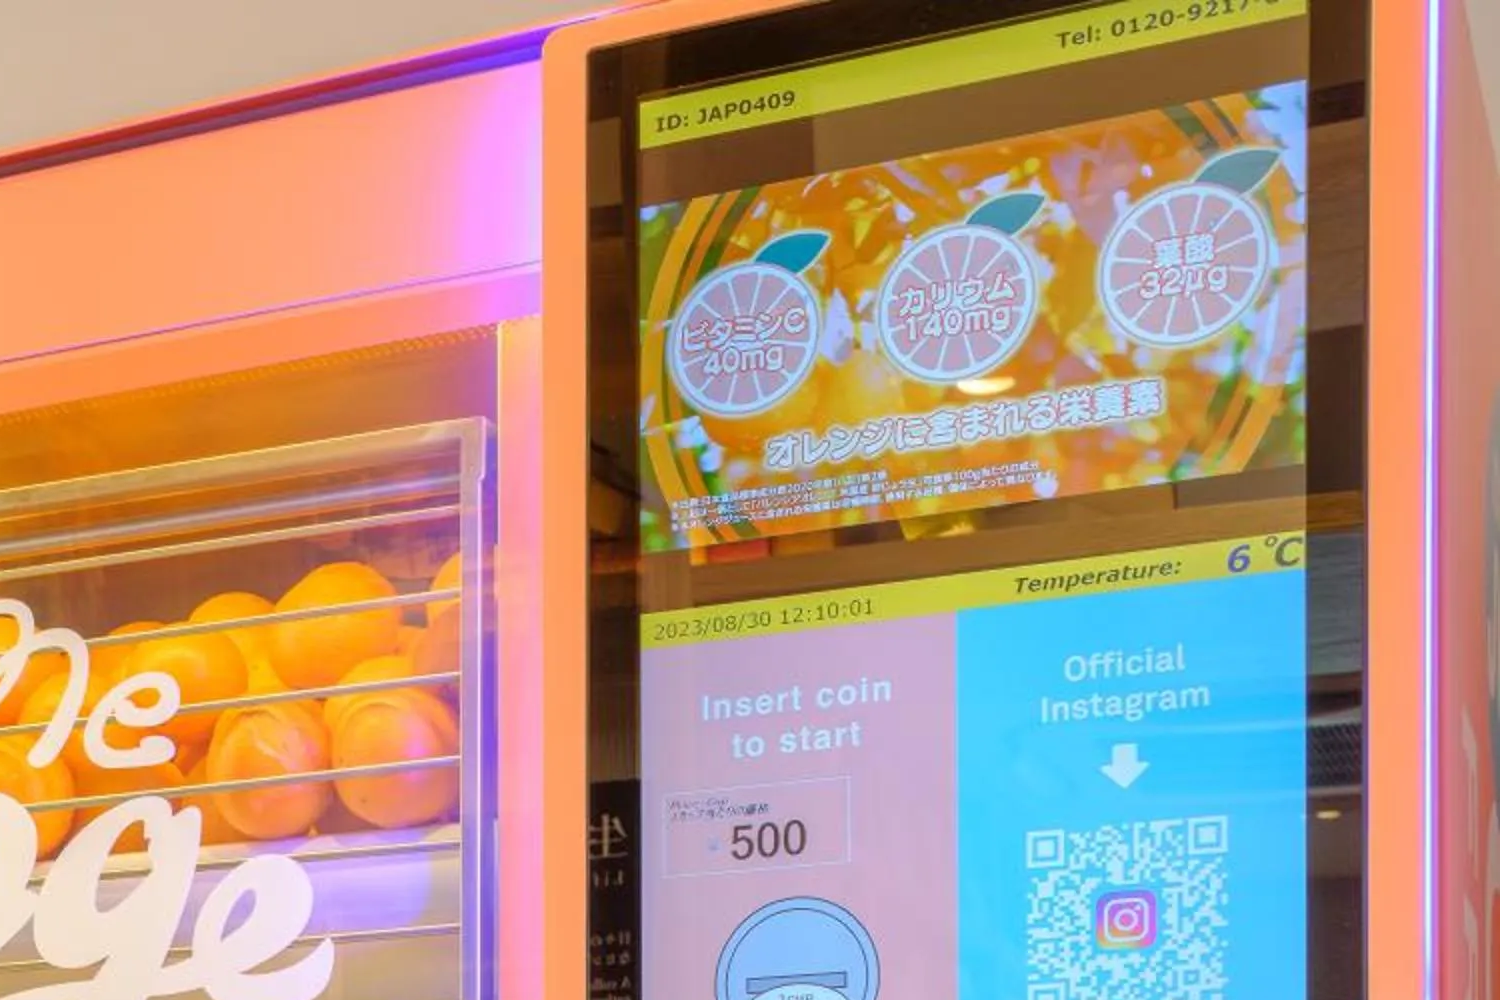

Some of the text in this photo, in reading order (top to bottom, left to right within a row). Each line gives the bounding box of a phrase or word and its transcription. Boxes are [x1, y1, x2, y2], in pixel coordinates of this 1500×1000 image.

[1056, 0, 1280, 49] Tel: 0120-9217-
[655, 90, 796, 133] ID: JAP0409
[1152, 234, 1215, 270] 葉酸
[899, 273, 1015, 318] カリウム
[680, 307, 806, 351] ビタミンC
[904, 304, 1012, 343] 140mg
[702, 345, 785, 378] 40mg
[1014, 558, 1182, 594] Temperature:
[1226, 542, 1251, 573] 6
[653, 598, 875, 641] 2023/08/30 12:10:01
[1064, 643, 1186, 682] Official
[701, 676, 893, 722] Insert coin
[1040, 682, 1211, 725] Instagram
[732, 721, 862, 759] to start
[731, 819, 807, 860] 500
